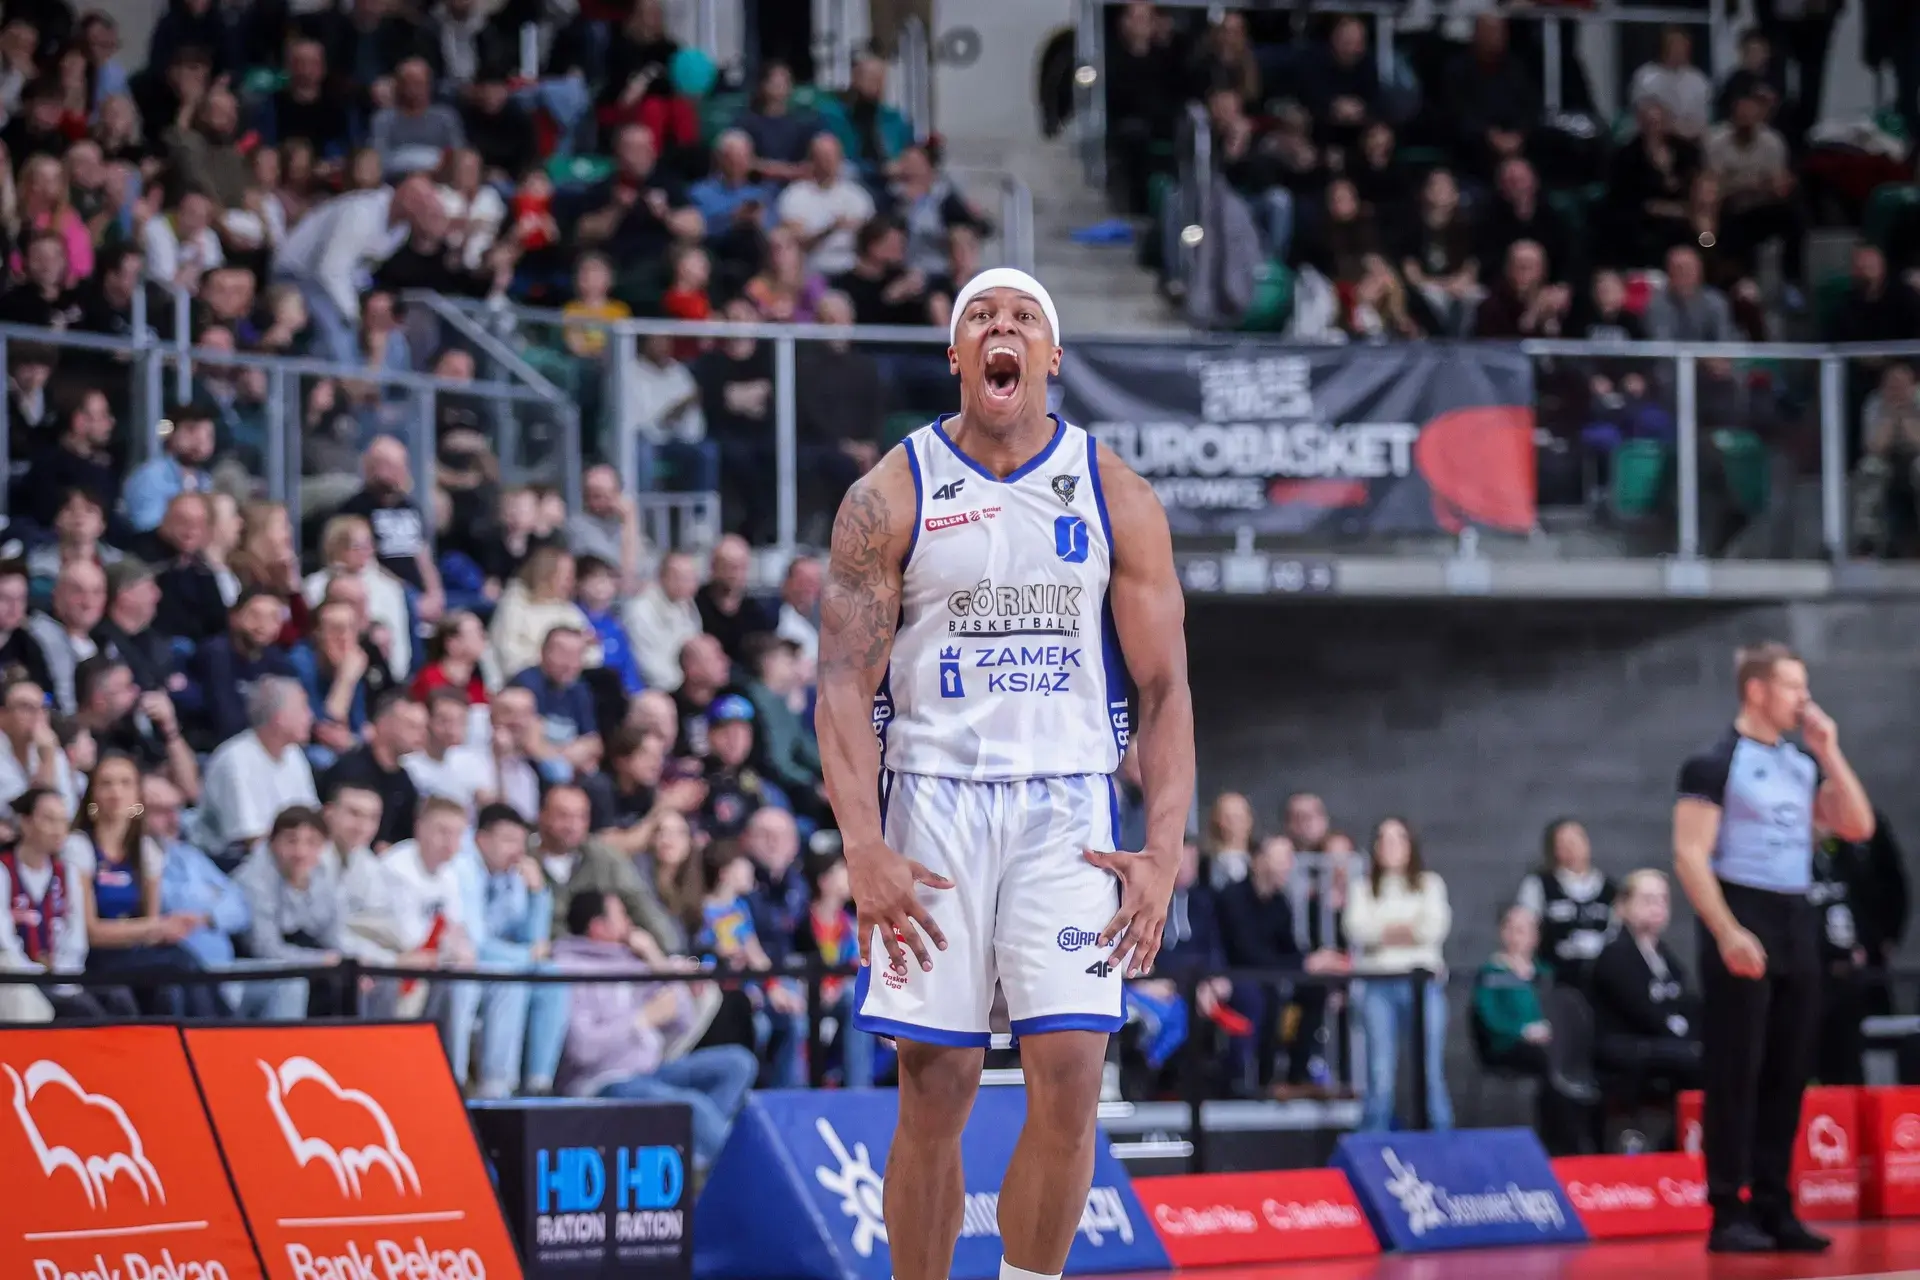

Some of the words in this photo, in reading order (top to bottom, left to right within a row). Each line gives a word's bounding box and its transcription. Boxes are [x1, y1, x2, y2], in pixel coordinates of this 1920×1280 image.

[928, 515, 965, 528] ORLEN
[1054, 515, 1089, 563] 0
[947, 578, 1082, 617] GÓRNIK
[949, 617, 1080, 632] BASKETBALL
[975, 646, 1082, 668] ZAMEK
[988, 666, 1071, 697] KSIĄŻ
[882, 971, 908, 984] Basket
[885, 979, 902, 990] Liga
[285, 1239, 380, 1280] Bank
[375, 1235, 487, 1280] Pekao
